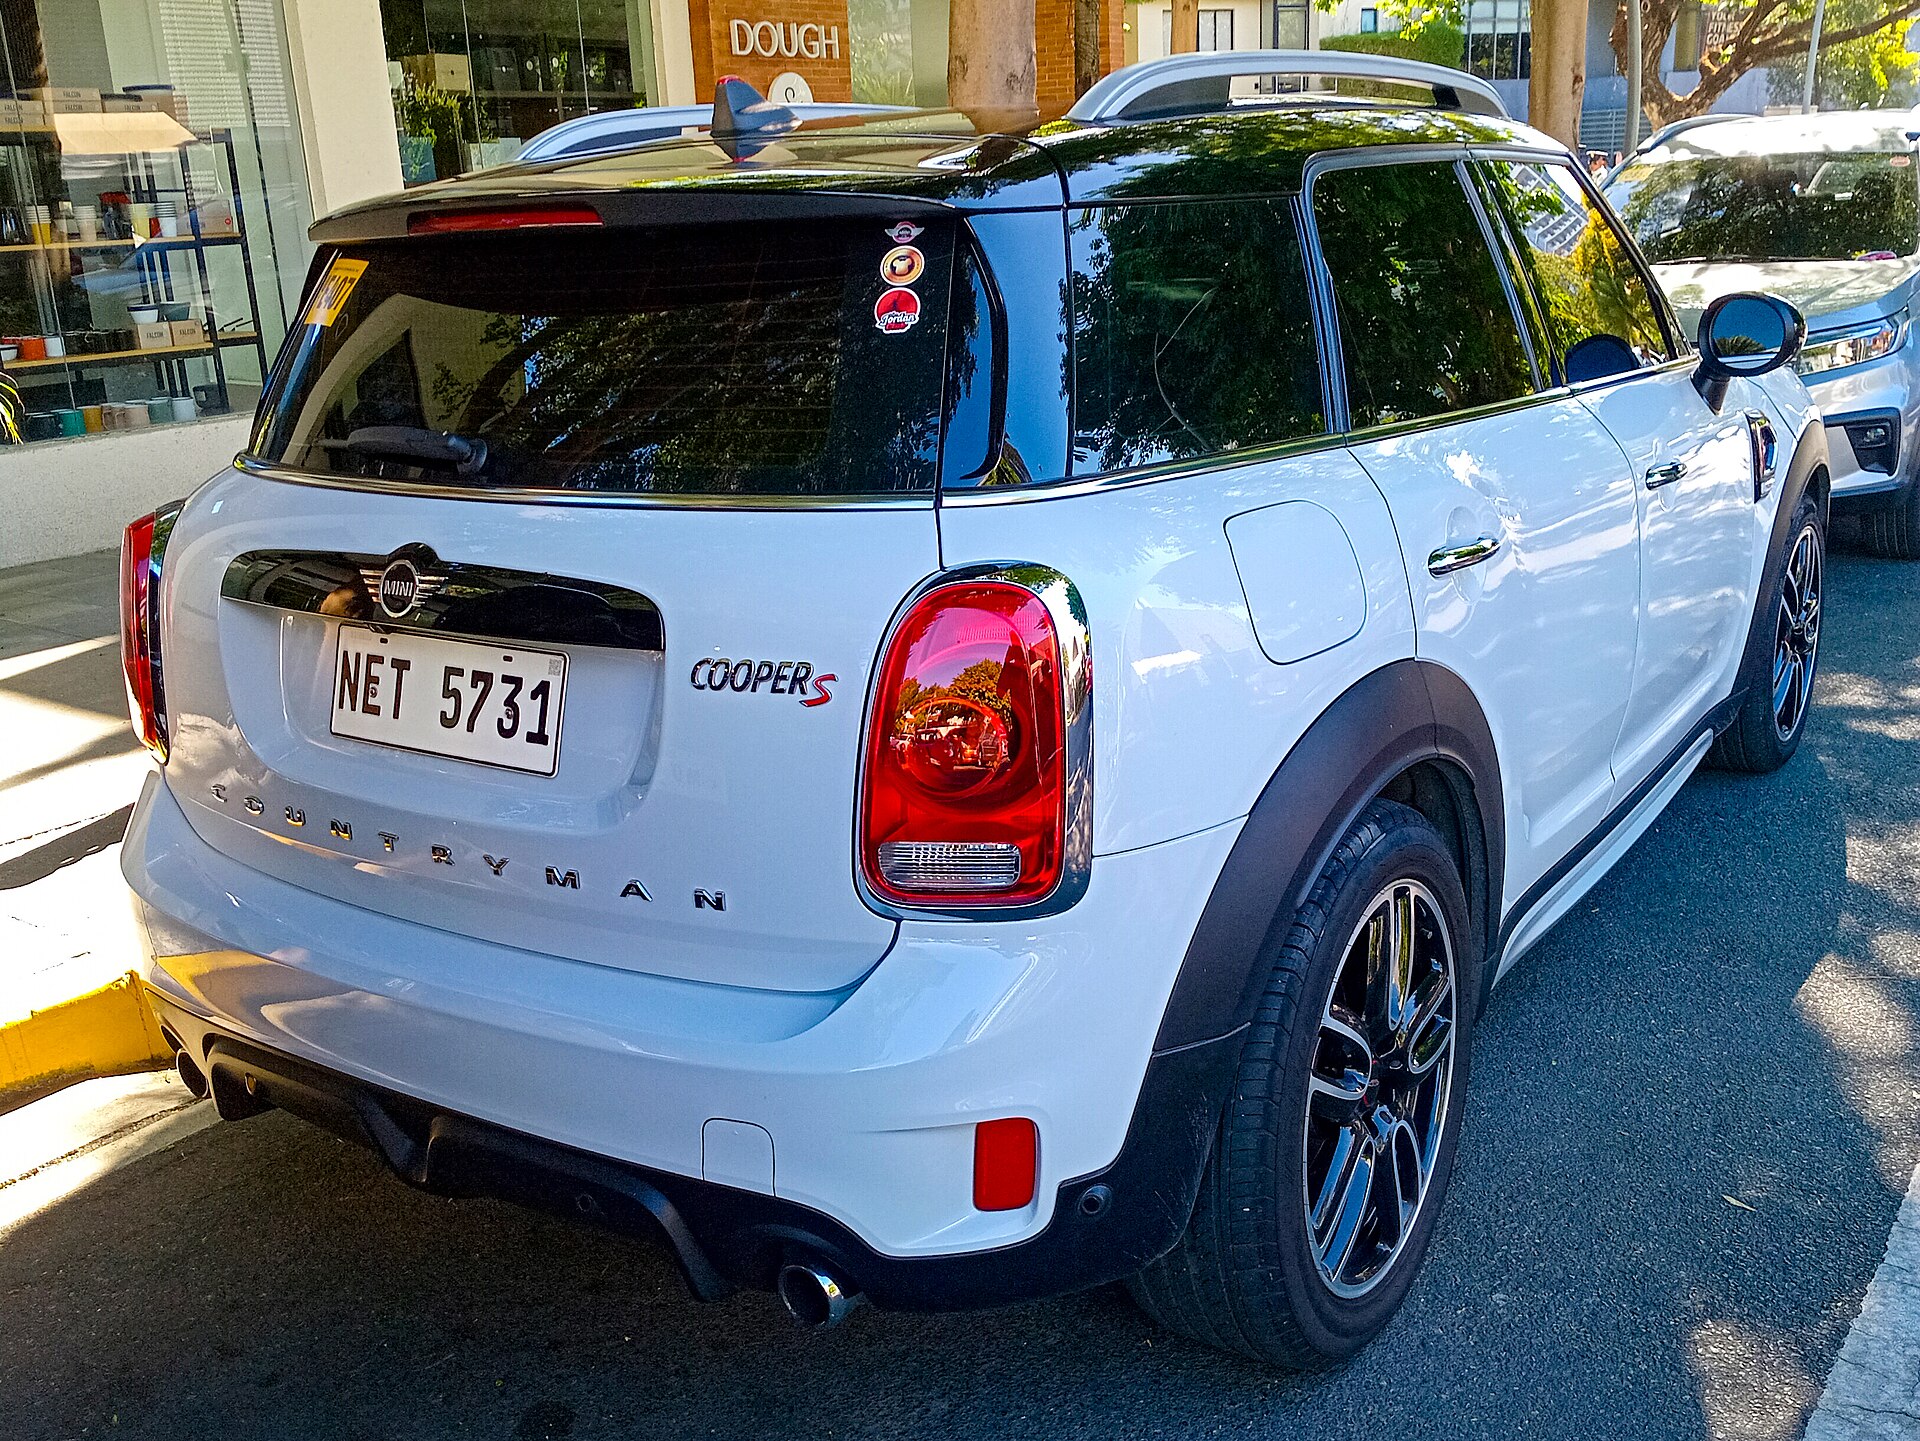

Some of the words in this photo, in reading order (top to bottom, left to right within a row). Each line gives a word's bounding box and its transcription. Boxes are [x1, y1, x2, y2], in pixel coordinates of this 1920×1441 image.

[730, 19, 839, 59] DOUGH
[63, 91, 81, 99] FALCON
[880, 311, 916, 325] Jordan
[146, 331, 164, 339] FALCON
[384, 579, 414, 597] MINI
[690, 657, 814, 695] COOPER
[799, 674, 838, 707] S
[338, 650, 411, 720] NET
[439, 665, 551, 746] 5731
[211, 783, 727, 912] COUNTRYMAN
